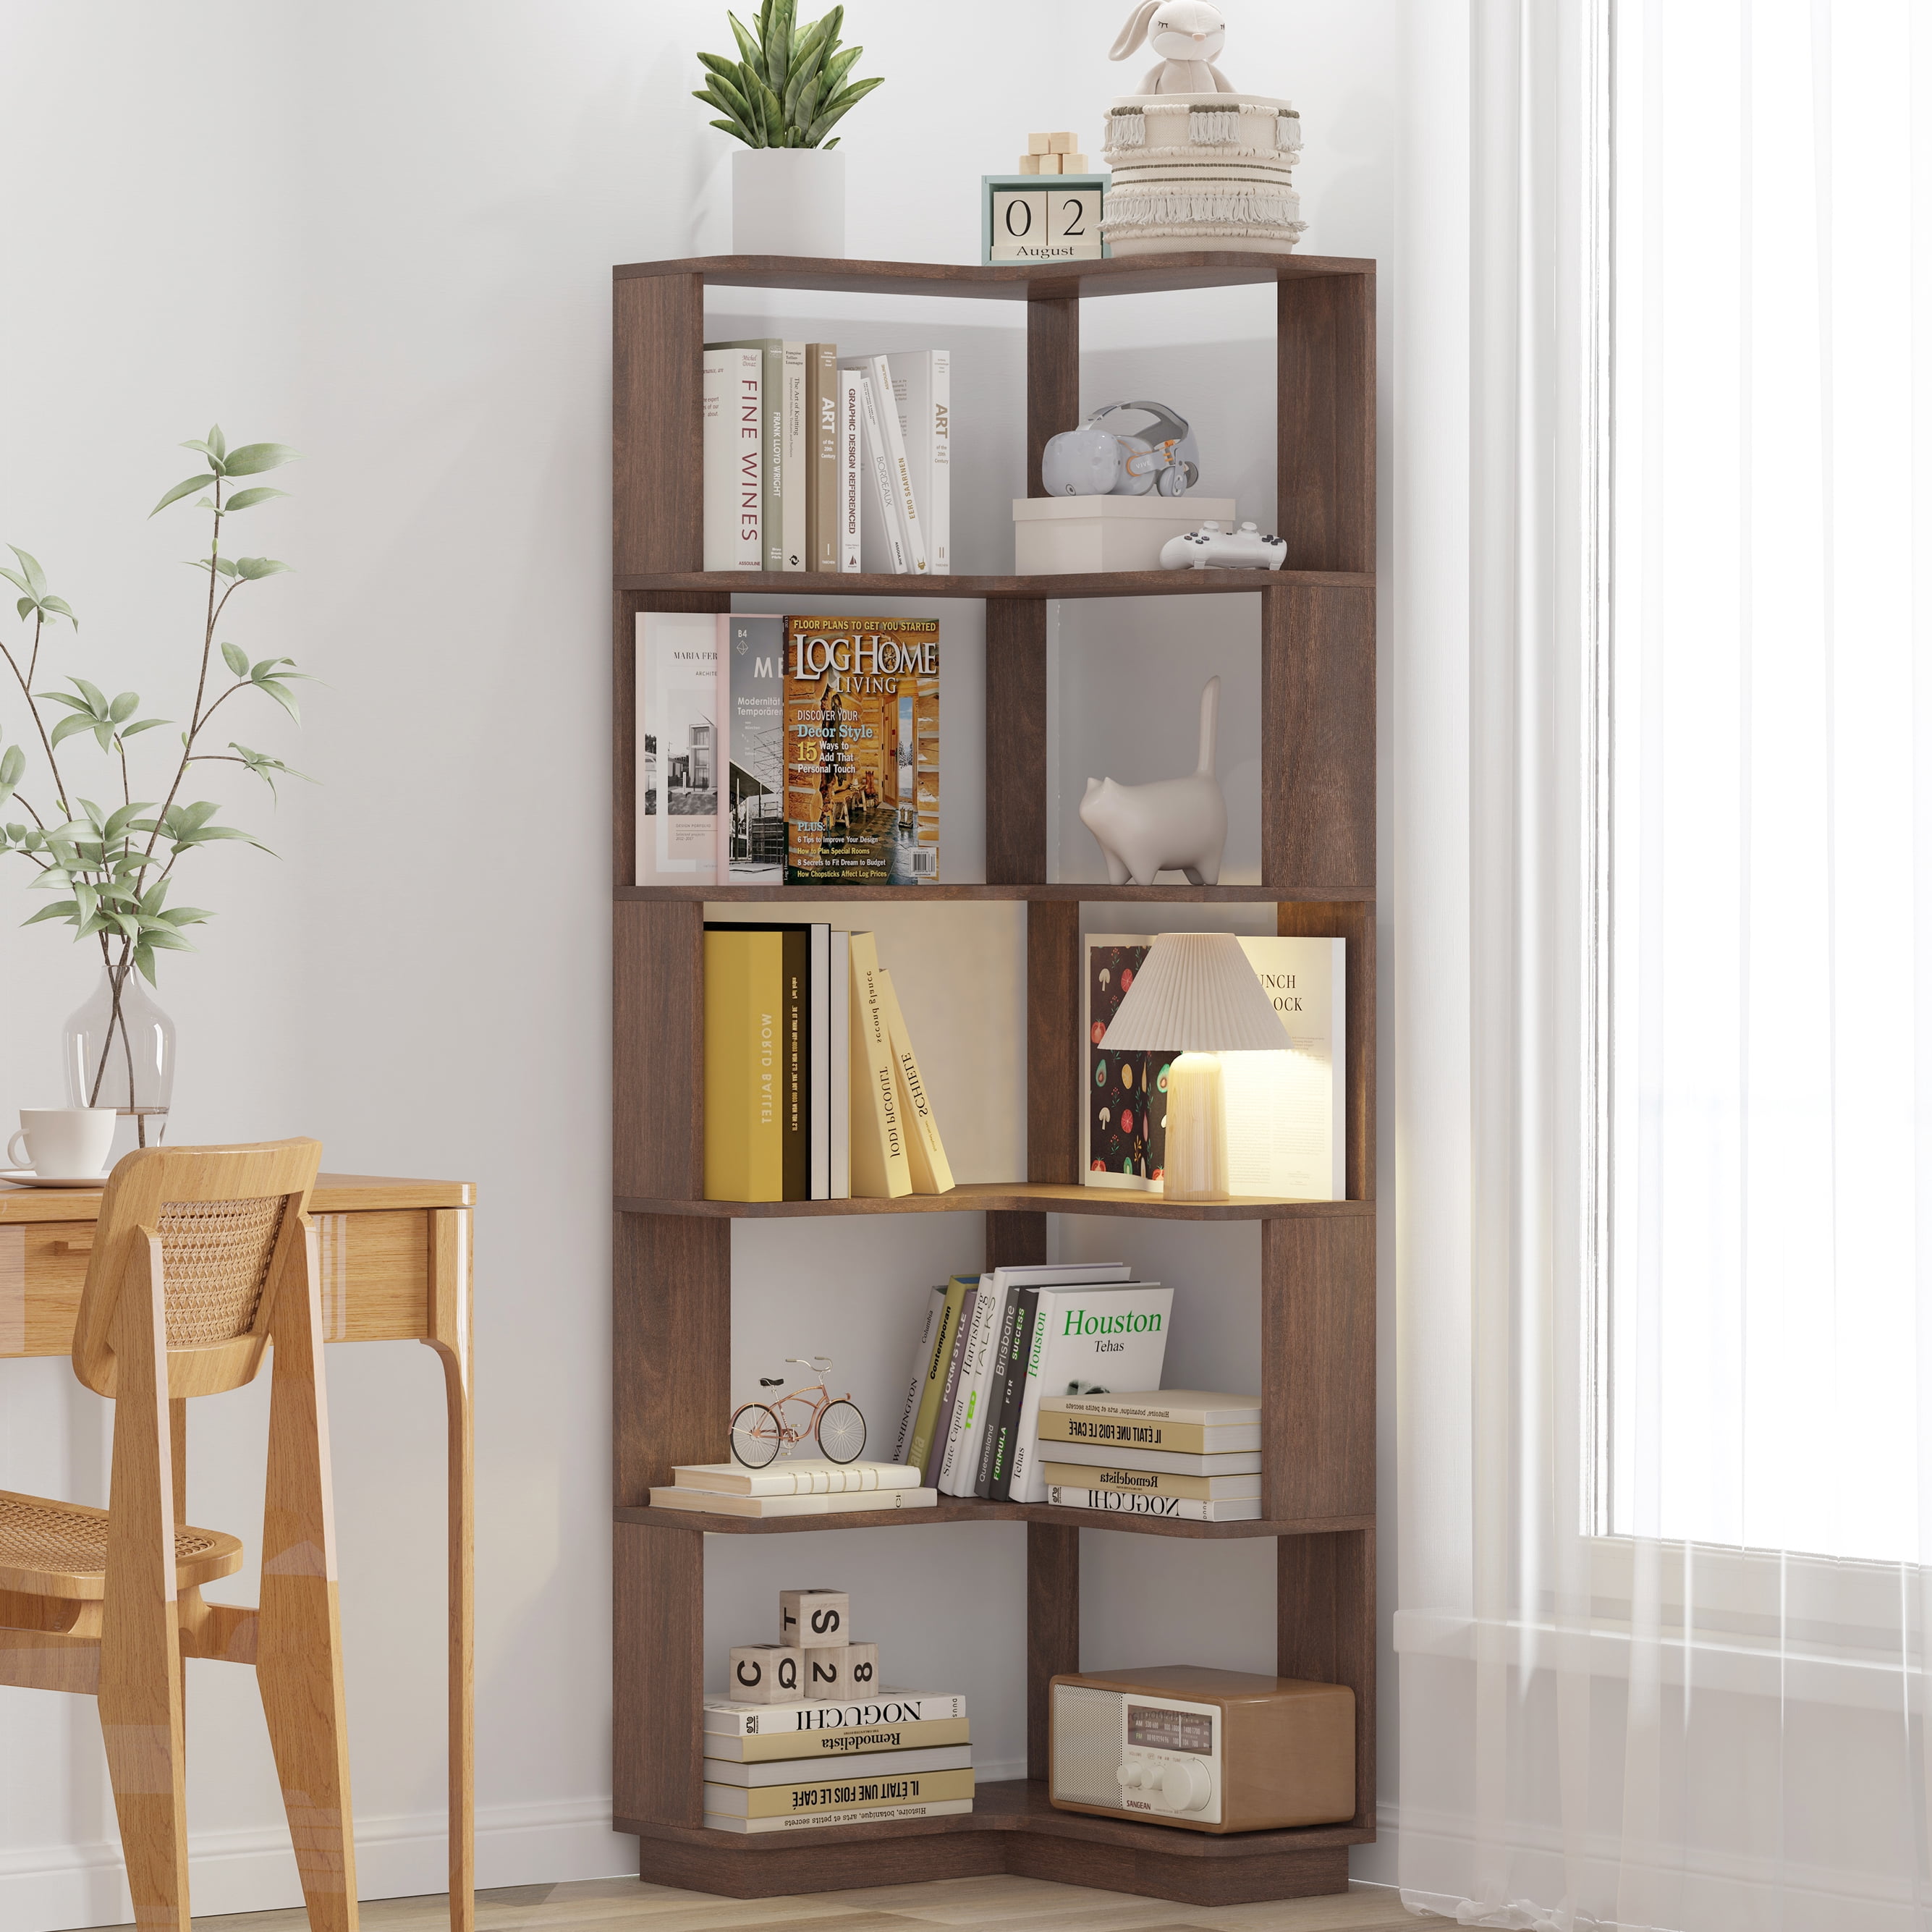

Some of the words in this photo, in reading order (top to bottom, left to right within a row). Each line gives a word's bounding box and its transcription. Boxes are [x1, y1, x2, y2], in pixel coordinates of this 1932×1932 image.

[1062, 199, 1085, 236] 2
[1016, 245, 1075, 259] August
[742, 380, 758, 439] FINE
[821, 397, 835, 433] ART
[935, 403, 948, 439] ART
[876, 456, 893, 507] BORDEAUX
[897, 457, 912, 497] SAARINEN
[742, 452, 758, 541] WINES
[906, 499, 915, 520] EERO
[894, 541, 903, 566] ASSOULINE
[794, 619, 820, 630] FLOOR
[823, 620, 849, 630] PLANS
[851, 621, 862, 630] TO
[864, 621, 880, 631] GET
[882, 621, 899, 631] YOU
[901, 622, 936, 632] STARTED
[674, 651, 700, 660] MARIA
[836, 677, 897, 694] LIVING
[737, 696, 780, 706] Modernität
[797, 710, 836, 721] DISCOVER
[837, 709, 858, 721] YOUR
[797, 724, 836, 737] Decor
[839, 724, 873, 742] Style
[797, 741, 818, 761] 15
[819, 740, 839, 751] Ways
[841, 741, 850, 750] to
[819, 752, 834, 762] Add
[836, 752, 855, 762] That
[797, 763, 831, 774] Personal
[833, 763, 856, 774] Touch
[797, 821, 826, 831] PLUS:
[803, 836, 815, 844] Tips
[823, 836, 845, 844] Improve
[860, 836, 878, 844] Design
[831, 847, 850, 856] Special
[1062, 1309, 1162, 1336] Houston
[1028, 1312, 1046, 1378] Houston
[1094, 1339, 1124, 1352] Tehas
[944, 1360, 957, 1402] FORM
[952, 1313, 967, 1358] STYLE
[893, 1377, 918, 1461] WASHINGTON
[922, 1310, 933, 1344] Columbia
[943, 1446, 955, 1476] State
[950, 1399, 964, 1442] Capital
[962, 1292, 988, 1375] Harrisburg
[980, 1424, 994, 1482] Queensland
[996, 1305, 1014, 1376] Brisbane
[993, 1427, 1007, 1481] FORMULA
[1012, 1308, 1025, 1360] SUCCESS
[784, 1606, 796, 1631] T
[811, 1609, 839, 1634] S
[737, 1660, 762, 1687] C
[778, 1658, 797, 1690] Q
[812, 1661, 837, 1683] 2
[854, 1661, 873, 1683] 8
[796, 1701, 922, 1731] NOGUCHI
[821, 1732, 901, 1750] Remodelista
[820, 1788, 832, 1805] LE
[834, 1787, 856, 1803] FOIS
[858, 1784, 878, 1801] UNE
[881, 1781, 907, 1800] ÉTAIT
[910, 1781, 919, 1796] IL
[792, 1790, 818, 1810] CAFÉ
[1127, 1800, 1151, 1810] SANGEAN
[784, 1818, 810, 1826] secrets
[812, 1815, 832, 1823] petits
[859, 1809, 895, 1818] botanique,
